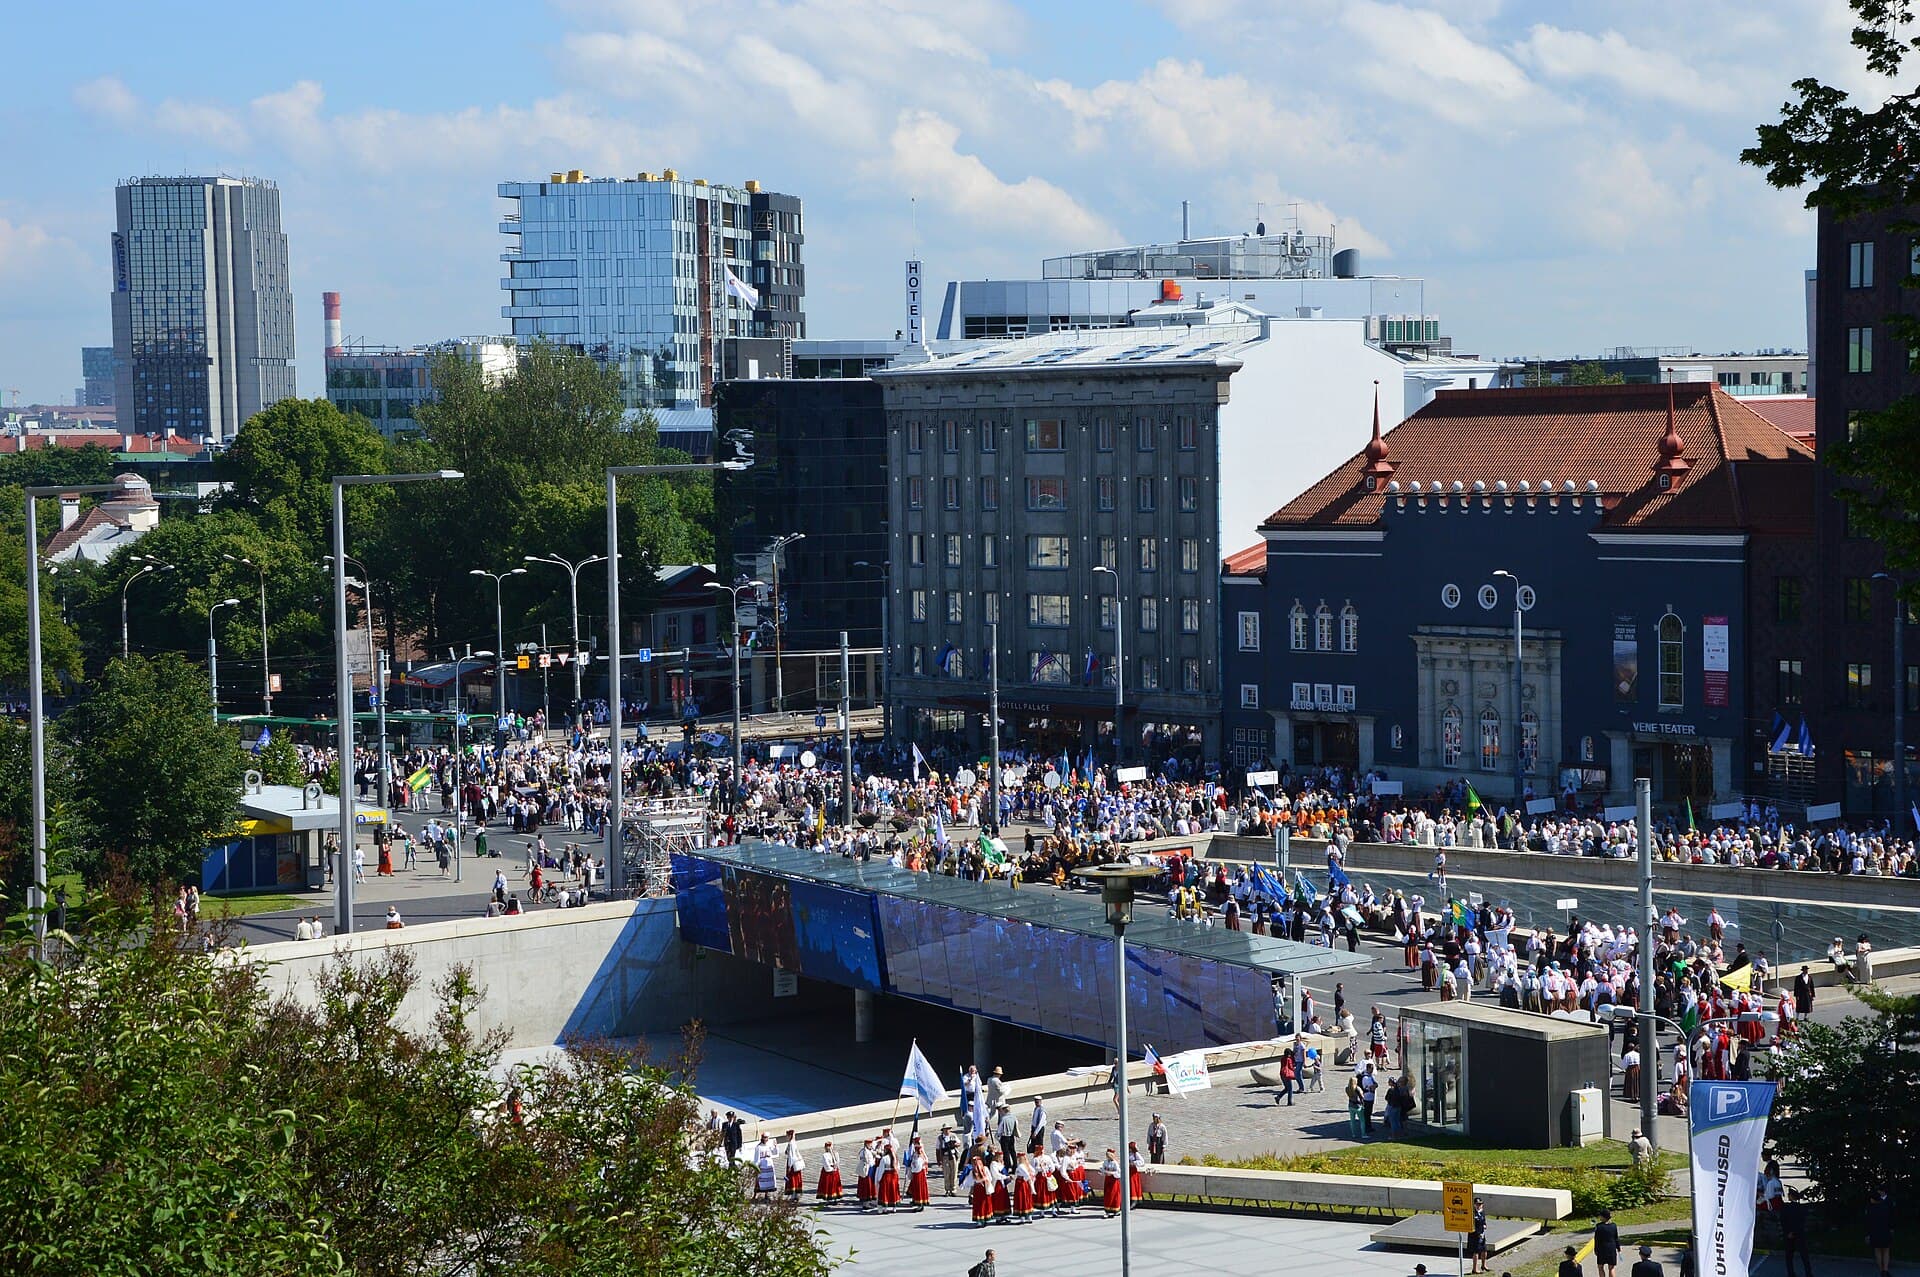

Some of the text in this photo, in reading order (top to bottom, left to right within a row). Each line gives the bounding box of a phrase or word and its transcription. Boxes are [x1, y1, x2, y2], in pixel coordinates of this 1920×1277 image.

[909, 263, 919, 344] HOTELL
[1023, 703, 1051, 712] PALACE
[1318, 702, 1349, 713] TEATER
[1632, 721, 1696, 735] VENE TEATER
[1716, 1090, 1742, 1116] P
[1446, 1186, 1469, 1194] TAKSO
